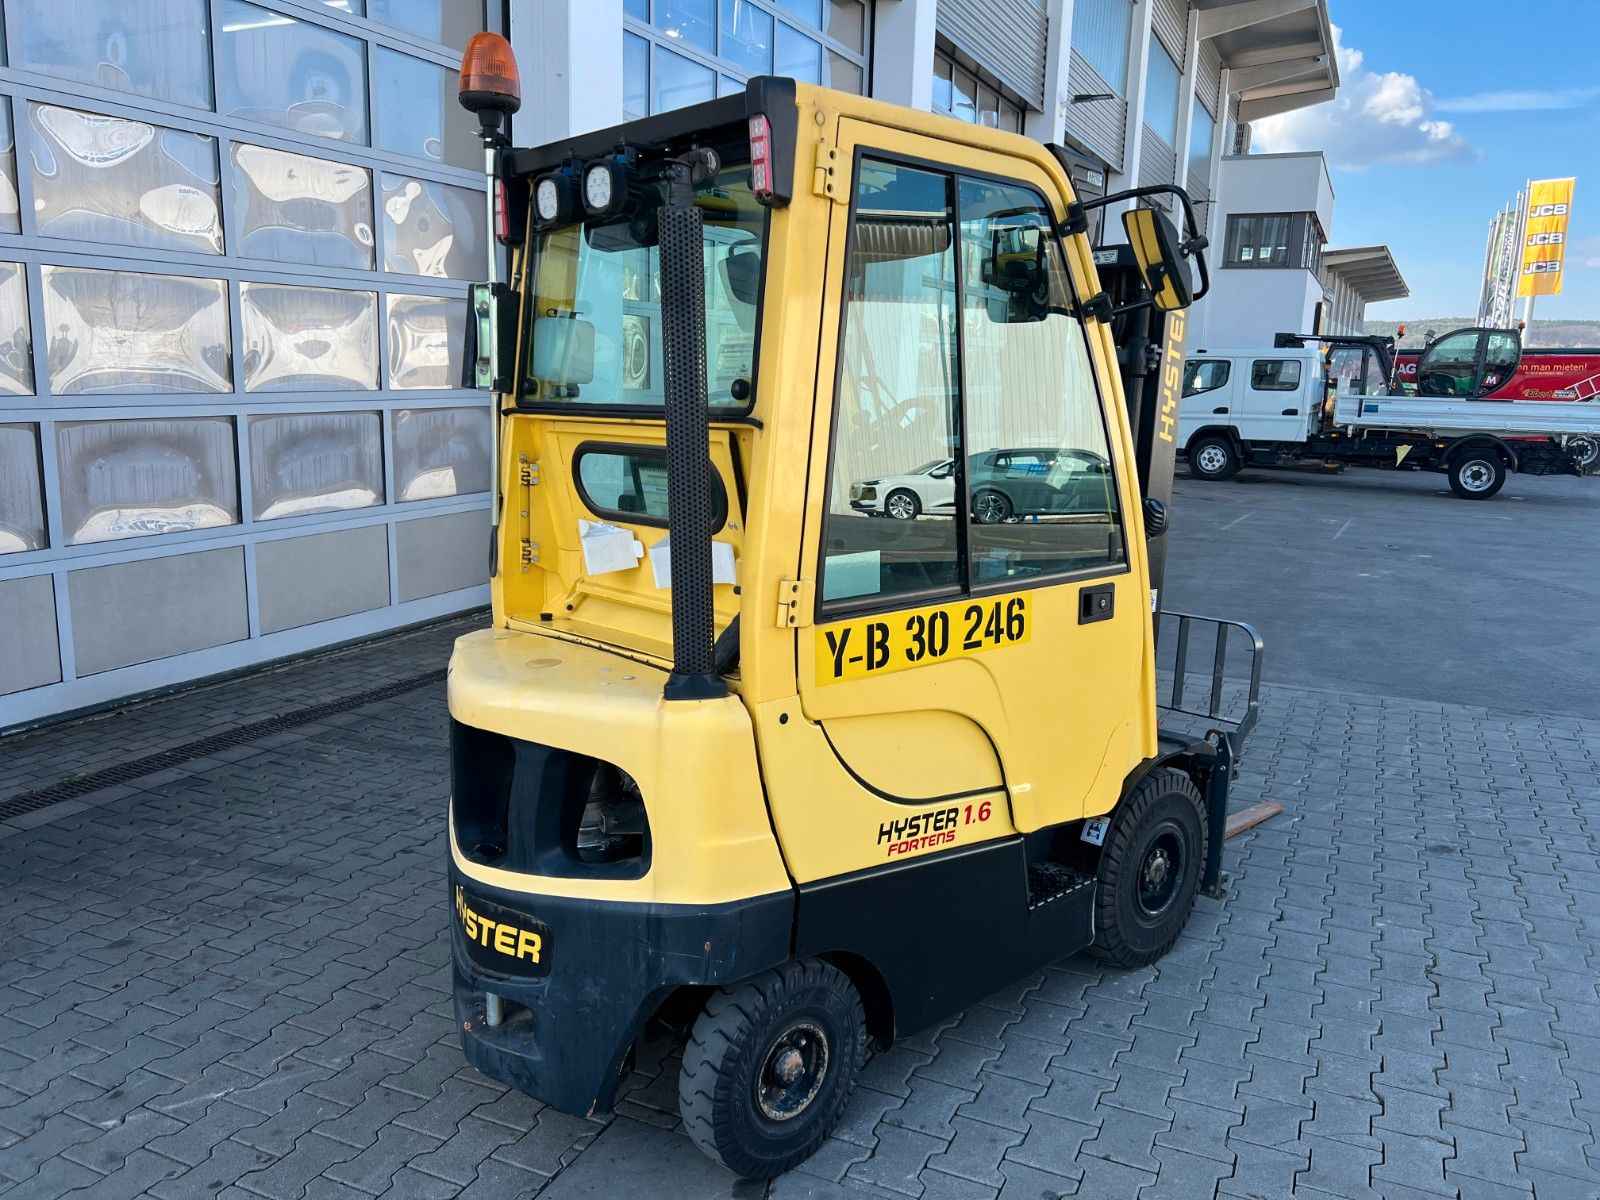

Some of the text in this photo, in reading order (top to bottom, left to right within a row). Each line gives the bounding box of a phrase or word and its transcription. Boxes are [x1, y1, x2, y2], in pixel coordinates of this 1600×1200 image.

[1530, 203, 1568, 218] JCB
[1527, 232, 1564, 246] JCB
[1524, 261, 1561, 274] JCB
[1553, 362, 1588, 371] mieten!
[825, 597, 1025, 678] Y-B 30 246
[877, 801, 992, 845] HYSTER 1.6
[887, 829, 956, 857] FORTENS
